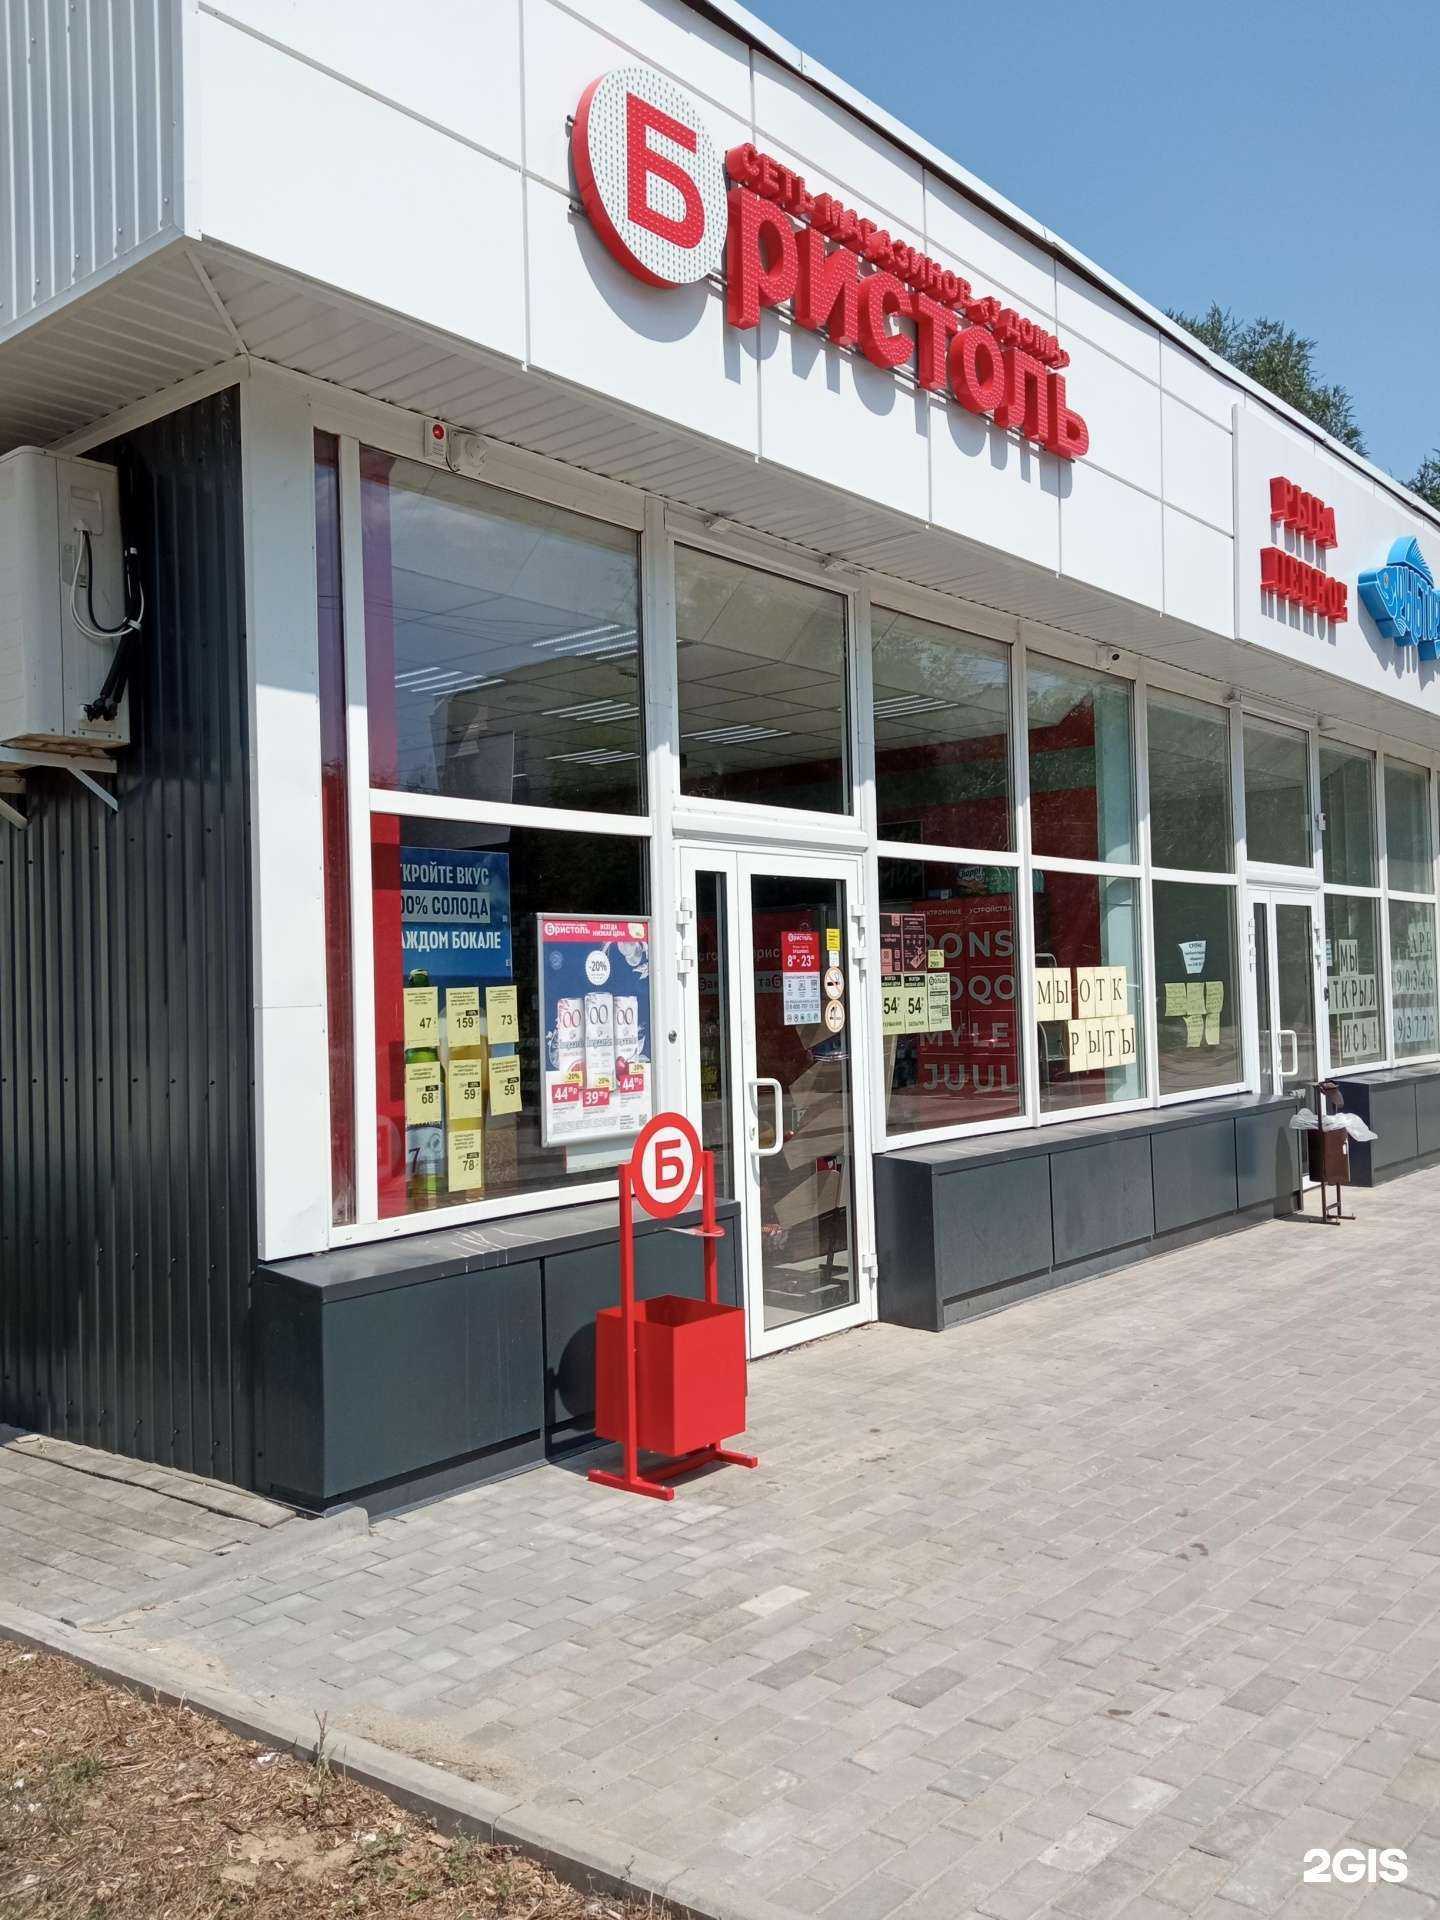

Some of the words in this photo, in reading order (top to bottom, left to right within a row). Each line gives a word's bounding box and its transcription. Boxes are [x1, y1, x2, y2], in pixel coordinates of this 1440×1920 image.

[400, 861, 454, 884] КРОЙТЕ
[457, 866, 489, 885] ВКУС
[432, 897, 489, 919] СОЛОДА
[452, 931, 502, 949] БОКАЛЕ
[1340, 944, 1358, 973] МЫ
[1037, 980, 1069, 1005] МЫ
[1080, 978, 1122, 1002] ОТК
[883, 997, 898, 1015] 54
[908, 997, 922, 1015] 54
[419, 1017, 432, 1029] 47
[456, 1017, 474, 1029] 159
[501, 1014, 513, 1026] 73
[1071, 1027, 1135, 1057] РЫТЫ
[923, 1064, 1014, 1092] JUUL
[421, 1093, 434, 1104] 68
[464, 1089, 476, 1100] 59
[504, 1085, 515, 1096] 59
[409, 1148, 420, 1173] 7
[462, 1160, 475, 1171] 78
[655, 1139, 684, 1190] Б
